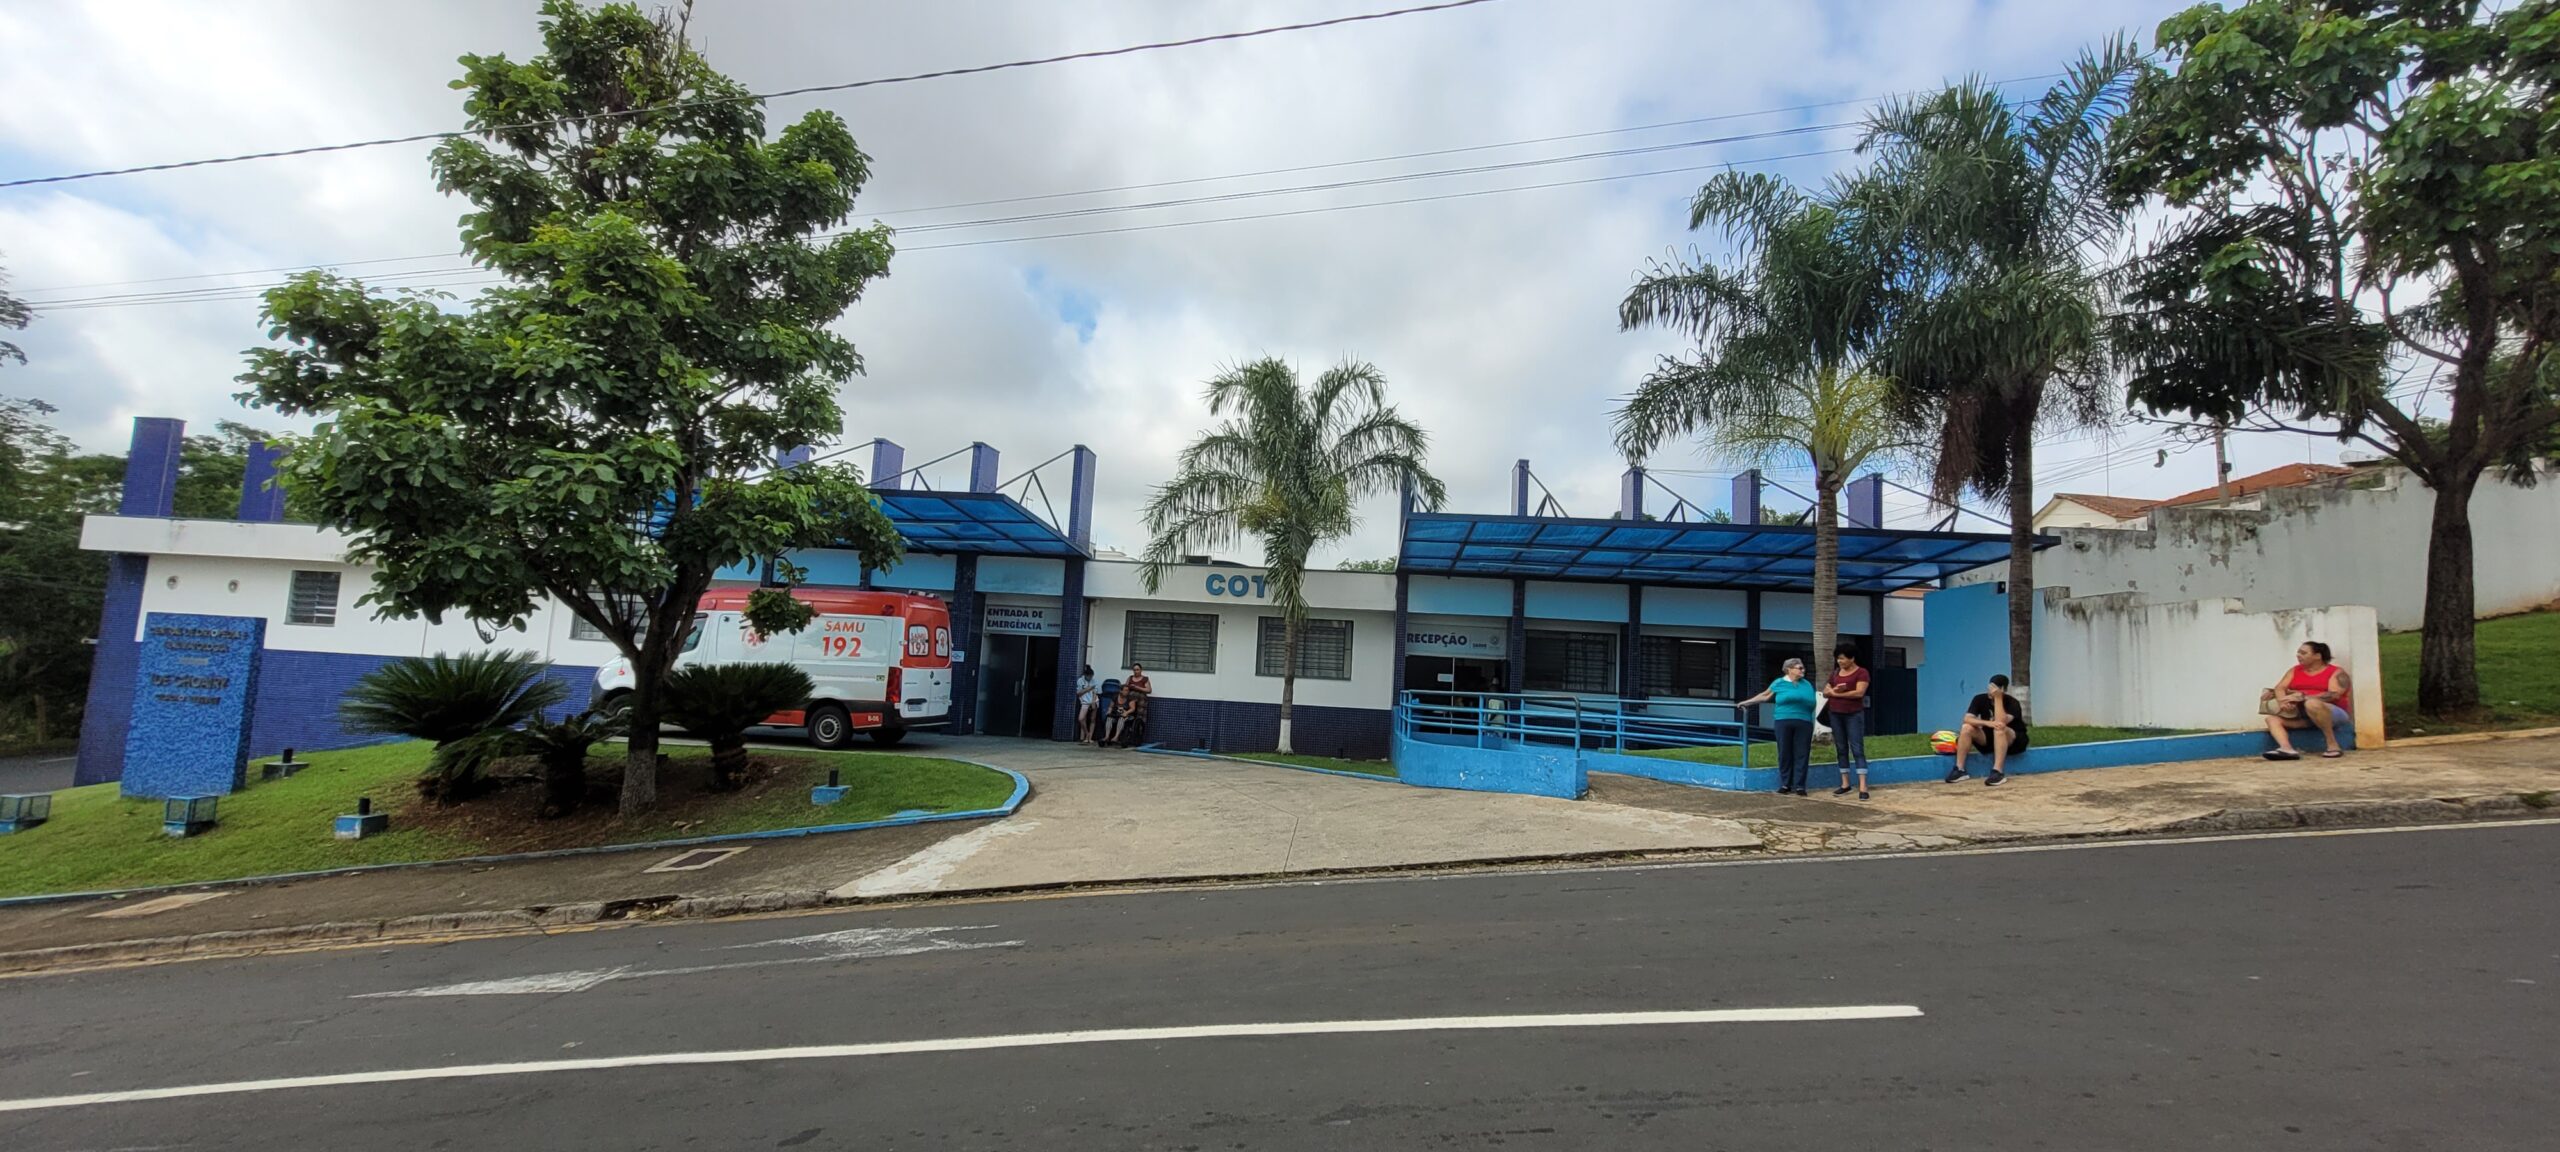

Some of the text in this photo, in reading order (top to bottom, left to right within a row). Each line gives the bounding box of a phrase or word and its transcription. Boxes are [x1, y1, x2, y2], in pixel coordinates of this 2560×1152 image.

[1206, 573, 1266, 598] COT
[987, 608, 1043, 618] ENTRADA DE
[824, 620, 866, 633] SAMU
[987, 618, 1042, 630] EMERGÊNCIA
[822, 636, 862, 657] 192
[1406, 632, 1468, 648] RECEPÇÃO
[911, 641, 927, 654] 192
